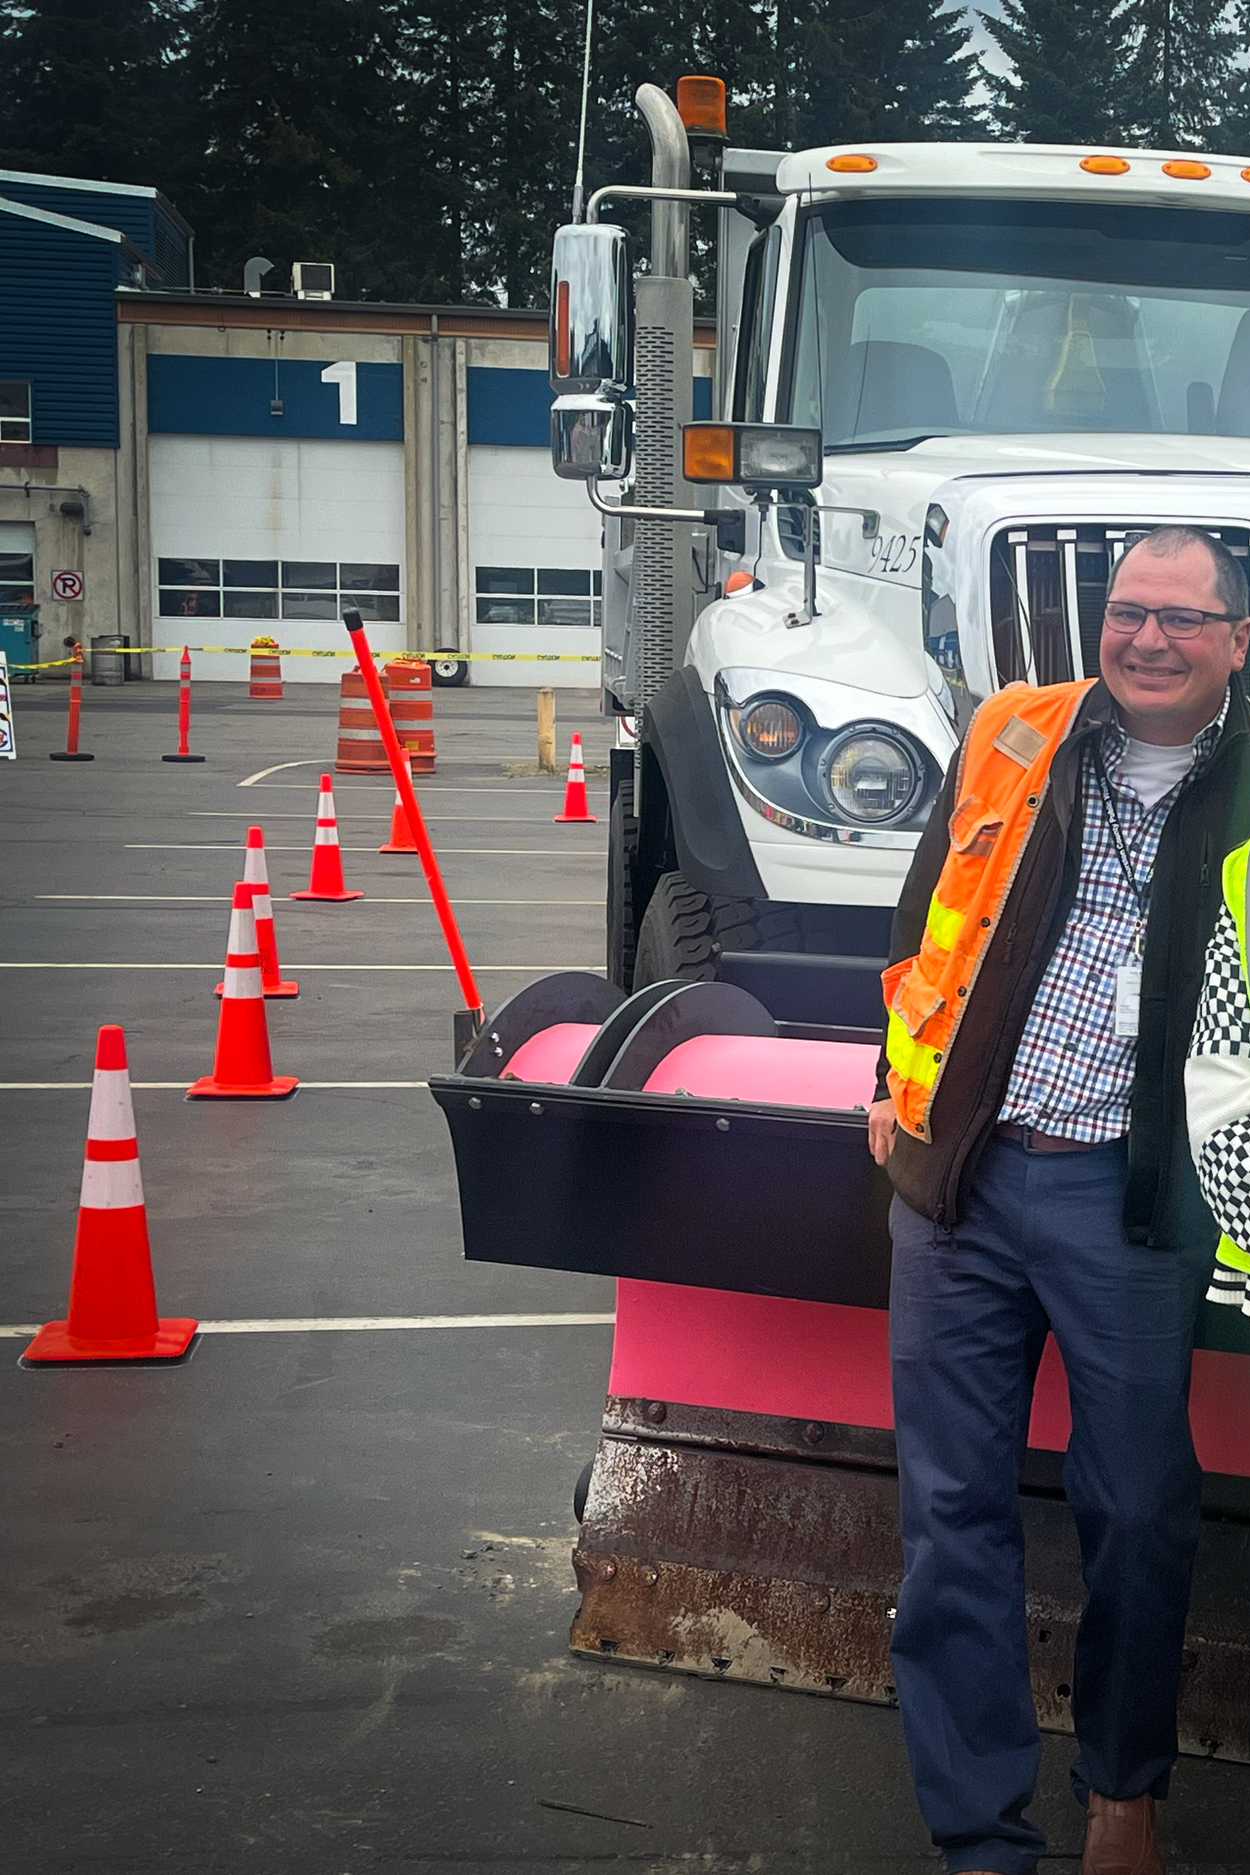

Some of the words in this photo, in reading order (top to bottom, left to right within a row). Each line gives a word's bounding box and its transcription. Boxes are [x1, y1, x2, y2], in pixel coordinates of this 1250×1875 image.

[321, 361, 357, 425] 1
[868, 535, 921, 573] 9425
[1112, 824, 1124, 850] County
